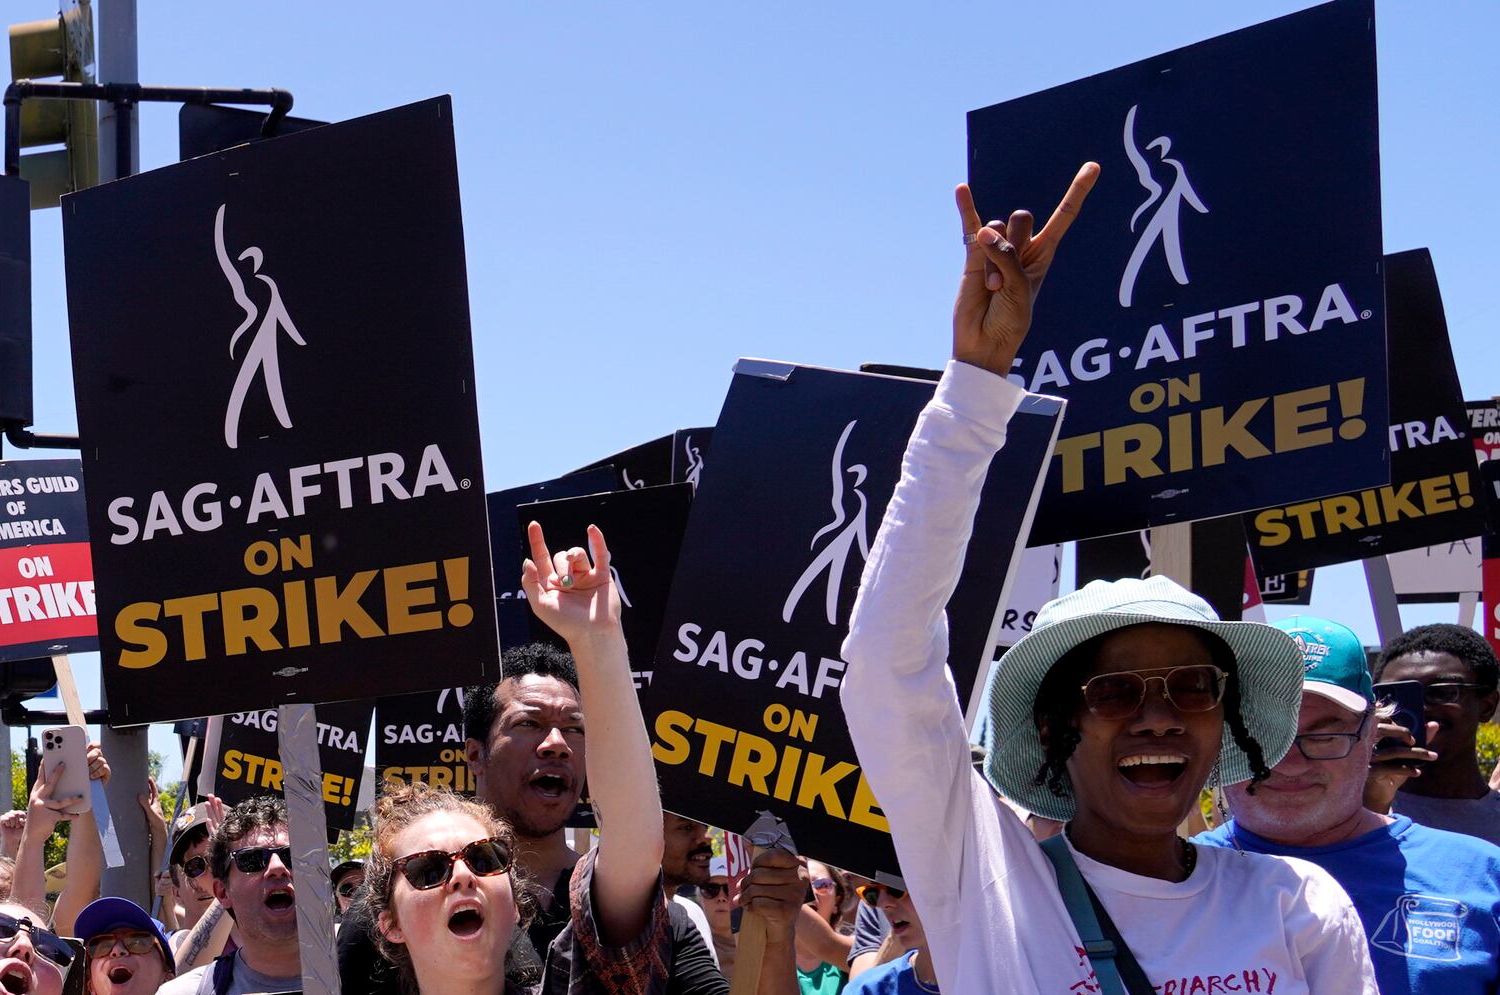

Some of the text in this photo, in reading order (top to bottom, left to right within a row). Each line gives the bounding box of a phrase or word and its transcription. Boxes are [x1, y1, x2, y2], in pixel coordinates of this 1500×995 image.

[1129, 373, 1201, 414] ON
[1053, 377, 1367, 494] TRIKE!
[26, 475, 80, 494] GUILD
[6, 501, 26, 516] OF
[1254, 472, 1475, 547] STRIKE!
[18, 556, 54, 579] ON
[243, 534, 314, 576] ON
[114, 556, 475, 669] STRIKE!
[763, 703, 818, 742] ON
[1412, 926, 1457, 942] FOOD
